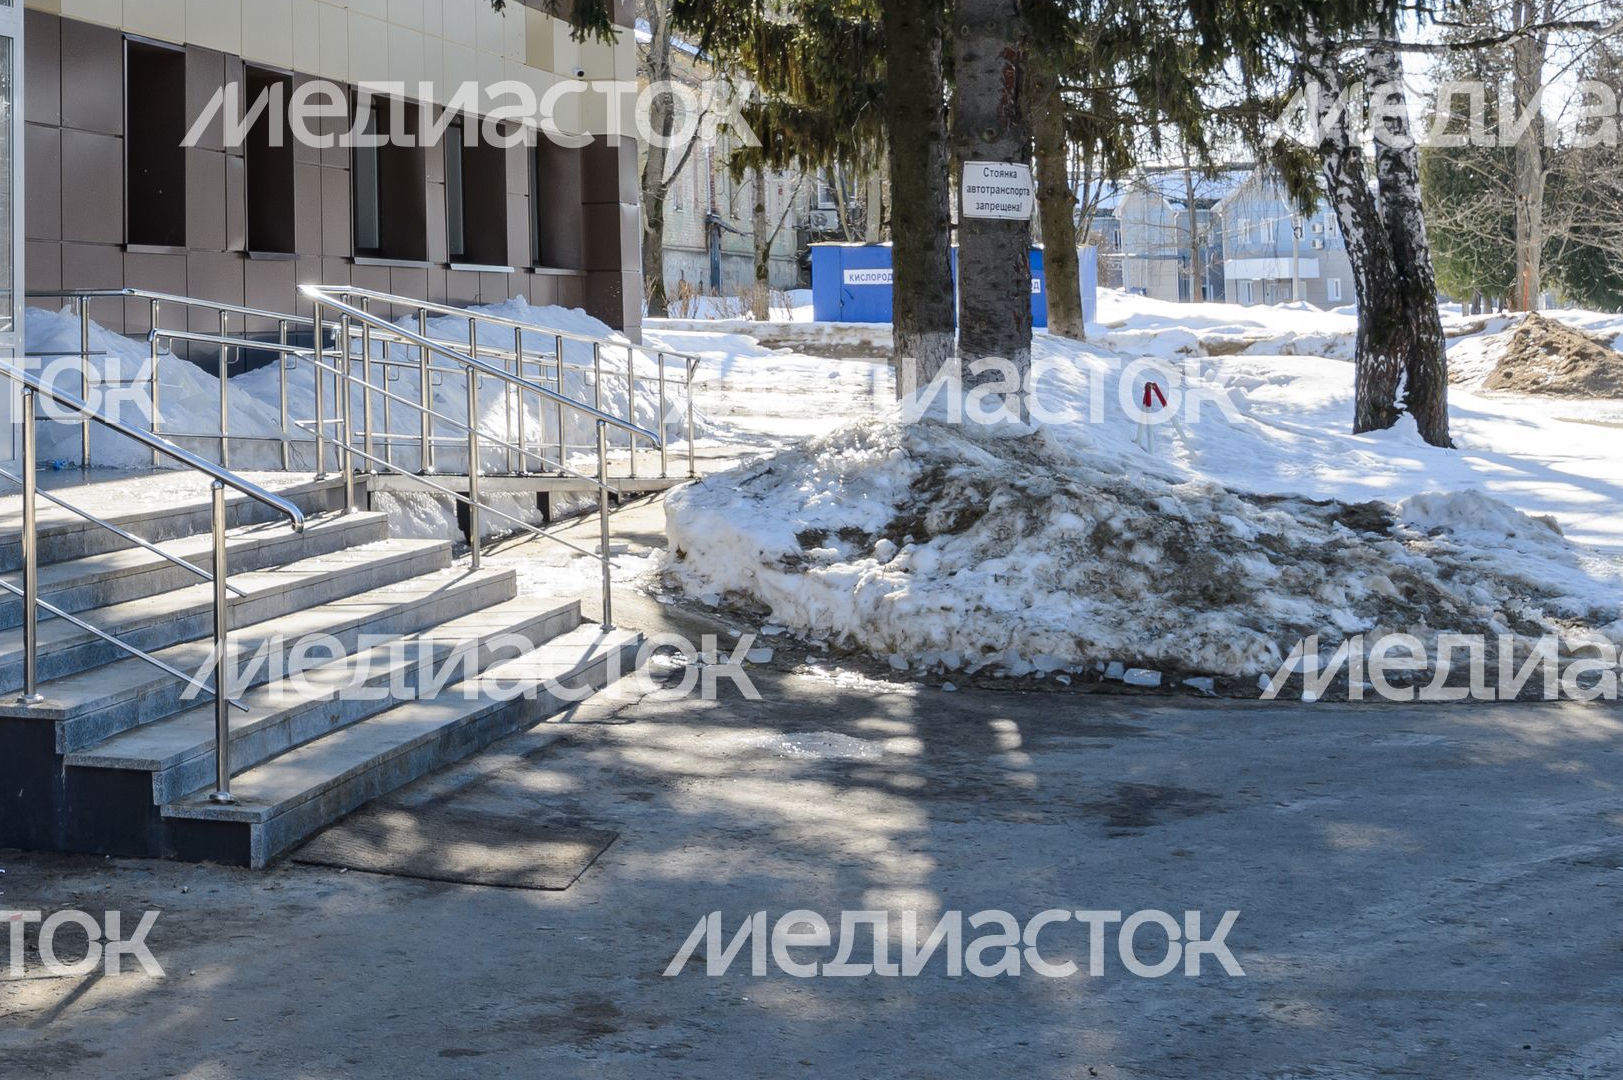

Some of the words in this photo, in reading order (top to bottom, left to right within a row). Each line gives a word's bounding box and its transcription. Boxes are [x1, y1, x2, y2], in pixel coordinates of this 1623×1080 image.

[983, 167, 1017, 179] Стоянка
[966, 185, 1030, 198] автотранспорта
[975, 202, 1023, 213] запрещена!
